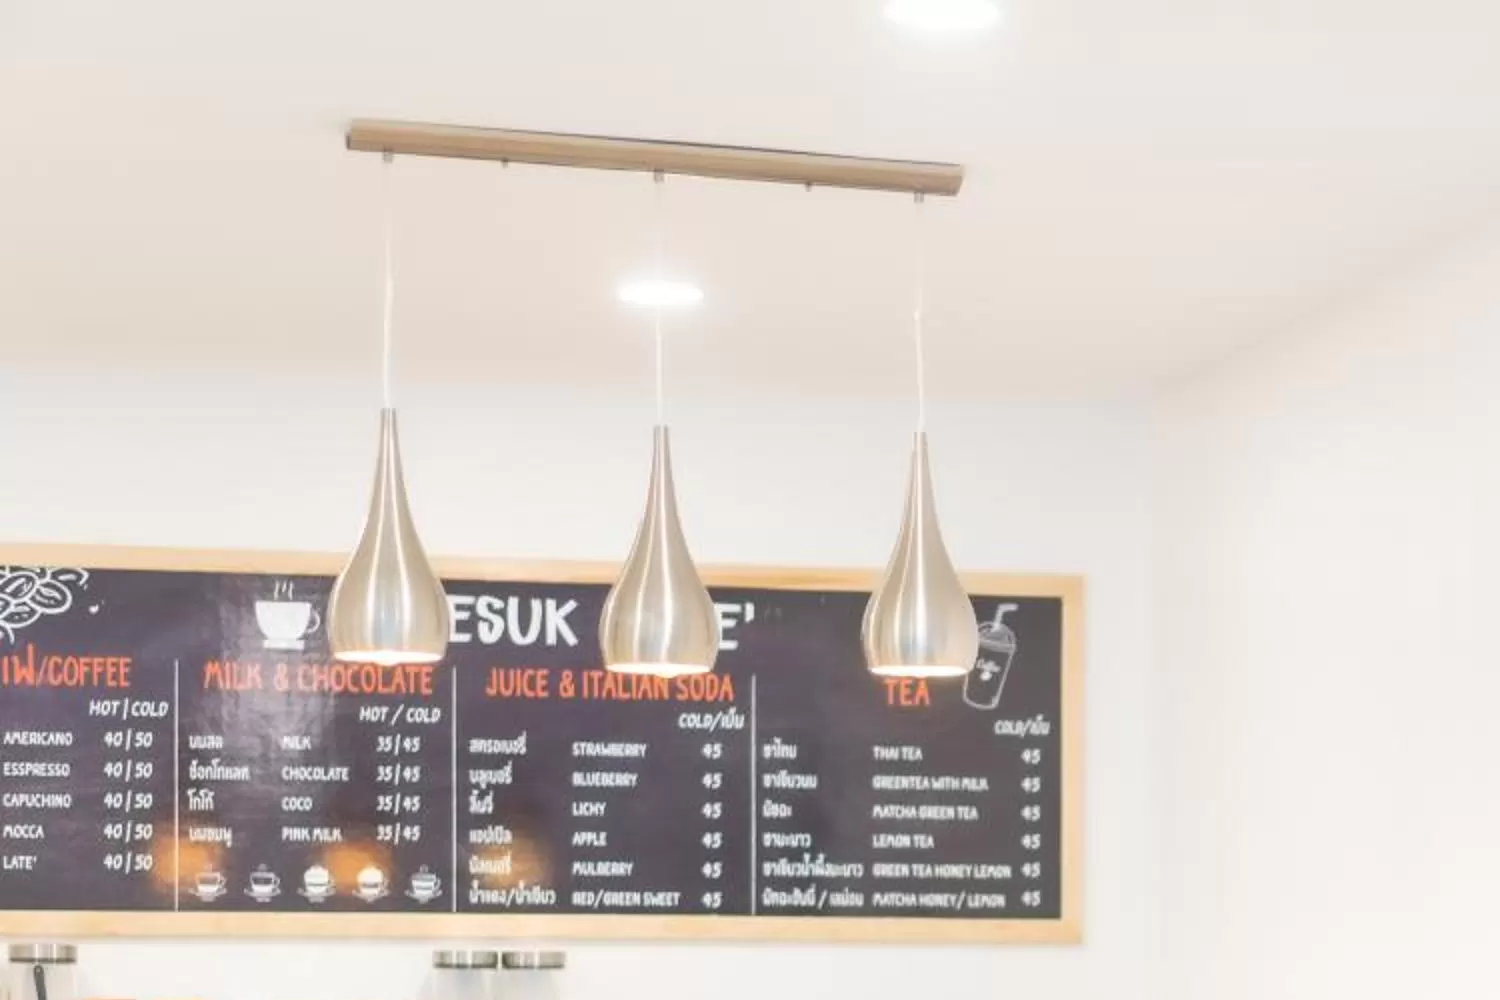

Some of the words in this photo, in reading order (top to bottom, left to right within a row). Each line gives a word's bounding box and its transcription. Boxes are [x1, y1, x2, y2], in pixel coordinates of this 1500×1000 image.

[204, 658, 262, 690] MILK
[274, 663, 289, 691] &
[297, 663, 433, 695] CHOCOLATE
[486, 667, 548, 697] JUICE
[559, 670, 574, 697] &
[583, 670, 668, 700] ITALIAN
[675, 673, 734, 702] SODA
[886, 677, 930, 706] TEA
[359, 706, 389, 722] HOT
[406, 707, 441, 724] COLD
[3, 731, 73, 747] AMERICANO
[282, 735, 312, 750] MILK
[572, 741, 647, 758] STRAWBERRY
[702, 743, 723, 760] 45
[873, 745, 899, 760] THAI
[901, 747, 924, 761] TEA
[1020, 748, 1041, 765] 45
[3, 762, 71, 777] ESSPRESSO
[281, 766, 349, 782] CHOCOLATE
[572, 771, 639, 788] BLUEBERRY
[702, 772, 723, 789] 45
[931, 776, 960, 791] WITH
[1020, 776, 1041, 793] 45
[2, 793, 72, 809] CAPUCHINO
[281, 796, 313, 812] COCO
[572, 802, 607, 817] LICHY
[702, 802, 723, 820] 45
[957, 805, 979, 820] TEA
[1020, 804, 1041, 822] 45
[2, 824, 45, 839] MOCCA
[281, 827, 310, 841] PINK
[312, 828, 343, 843] MILK
[571, 831, 608, 847] APPLE
[702, 832, 723, 849] 45
[871, 833, 911, 849] LEMON
[913, 834, 935, 849] TEA
[1020, 833, 1041, 850] 45
[3, 855, 38, 870] LATE'
[571, 860, 634, 877] MULBERRY
[702, 861, 723, 879] 45
[871, 862, 910, 878] GREEN
[911, 863, 932, 878] TEA
[973, 864, 1013, 879] LEMON
[1020, 862, 1041, 879] 45
[643, 892, 682, 907] SWEET
[702, 891, 723, 910] 45
[966, 893, 1006, 908] LEMON
[1020, 890, 1041, 907] 45
